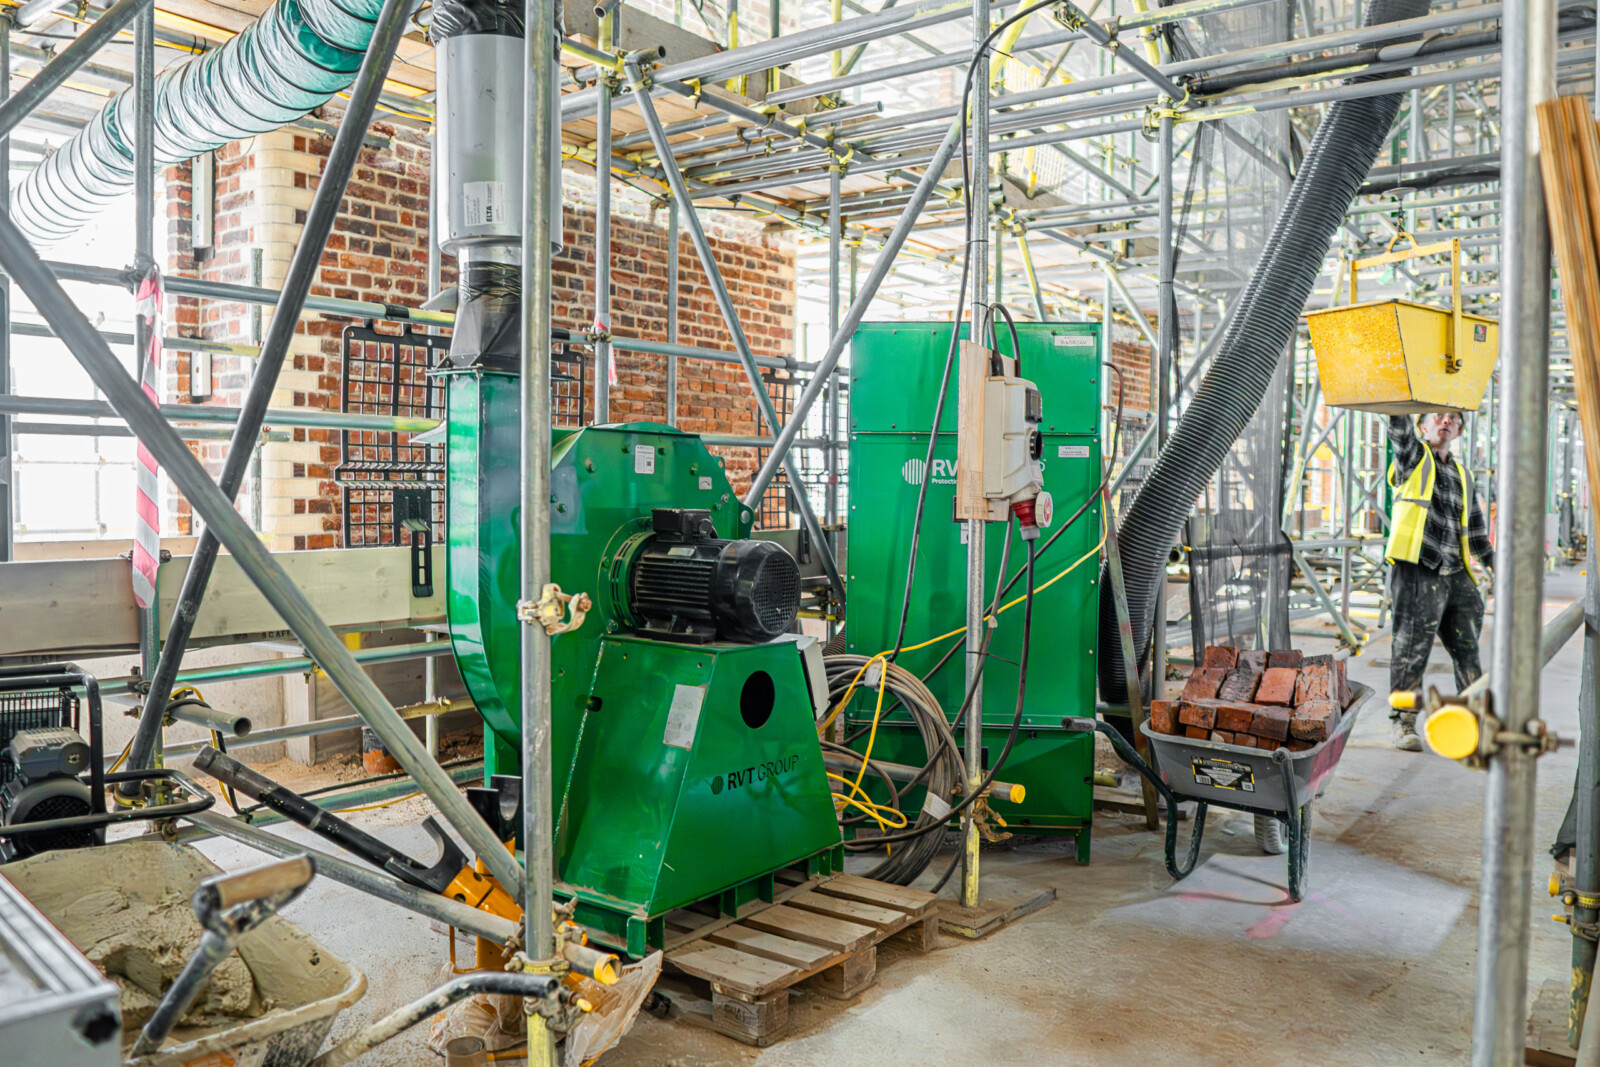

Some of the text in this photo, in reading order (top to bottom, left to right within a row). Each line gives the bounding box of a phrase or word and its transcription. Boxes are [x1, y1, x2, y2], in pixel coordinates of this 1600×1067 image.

[931, 459, 958, 477] RV
[728, 755, 799, 790] RVT GROUP
